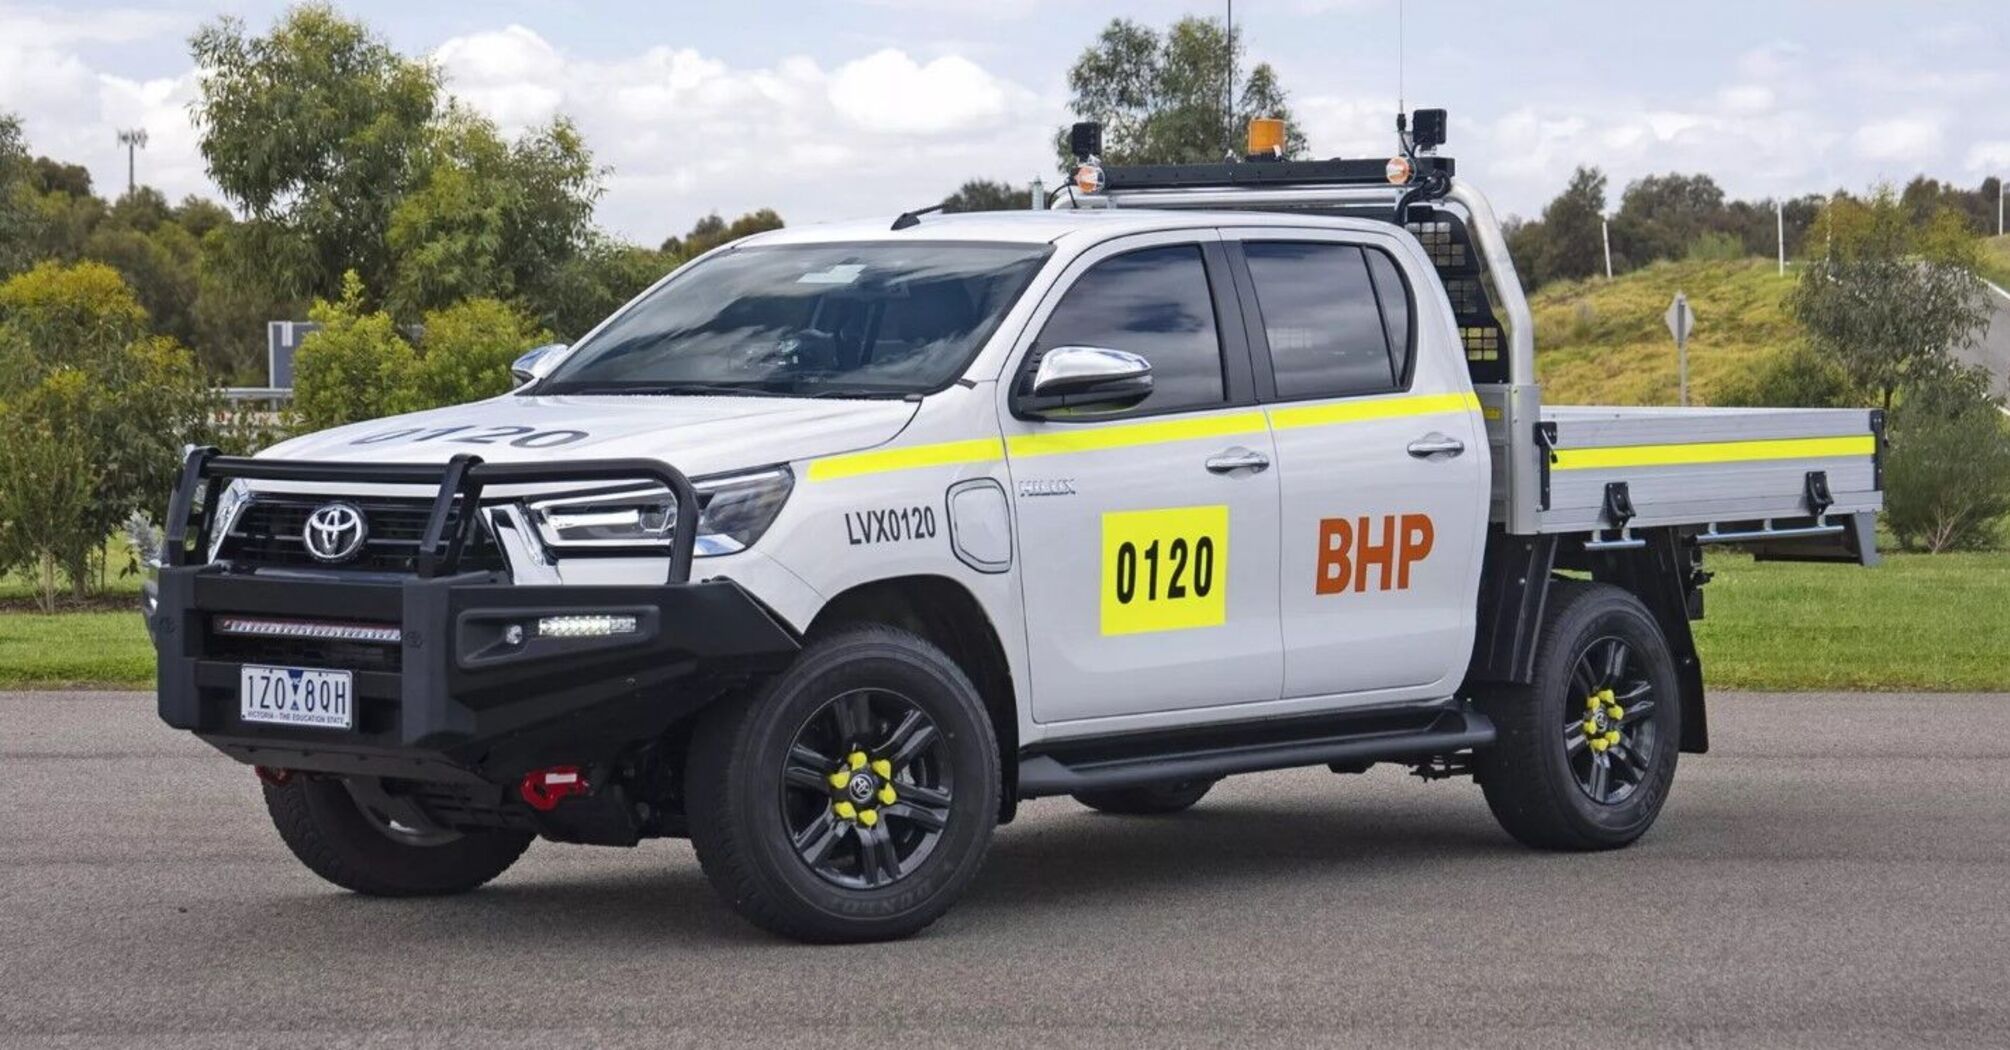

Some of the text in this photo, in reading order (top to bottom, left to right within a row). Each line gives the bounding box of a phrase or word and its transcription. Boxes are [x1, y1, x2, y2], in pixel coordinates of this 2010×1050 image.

[350, 425, 590, 448] 0120
[845, 505, 936, 545] LVX0120
[1116, 536, 1213, 604] 0120
[1316, 513, 1434, 595] BHP
[305, 679, 346, 714] 8QH
